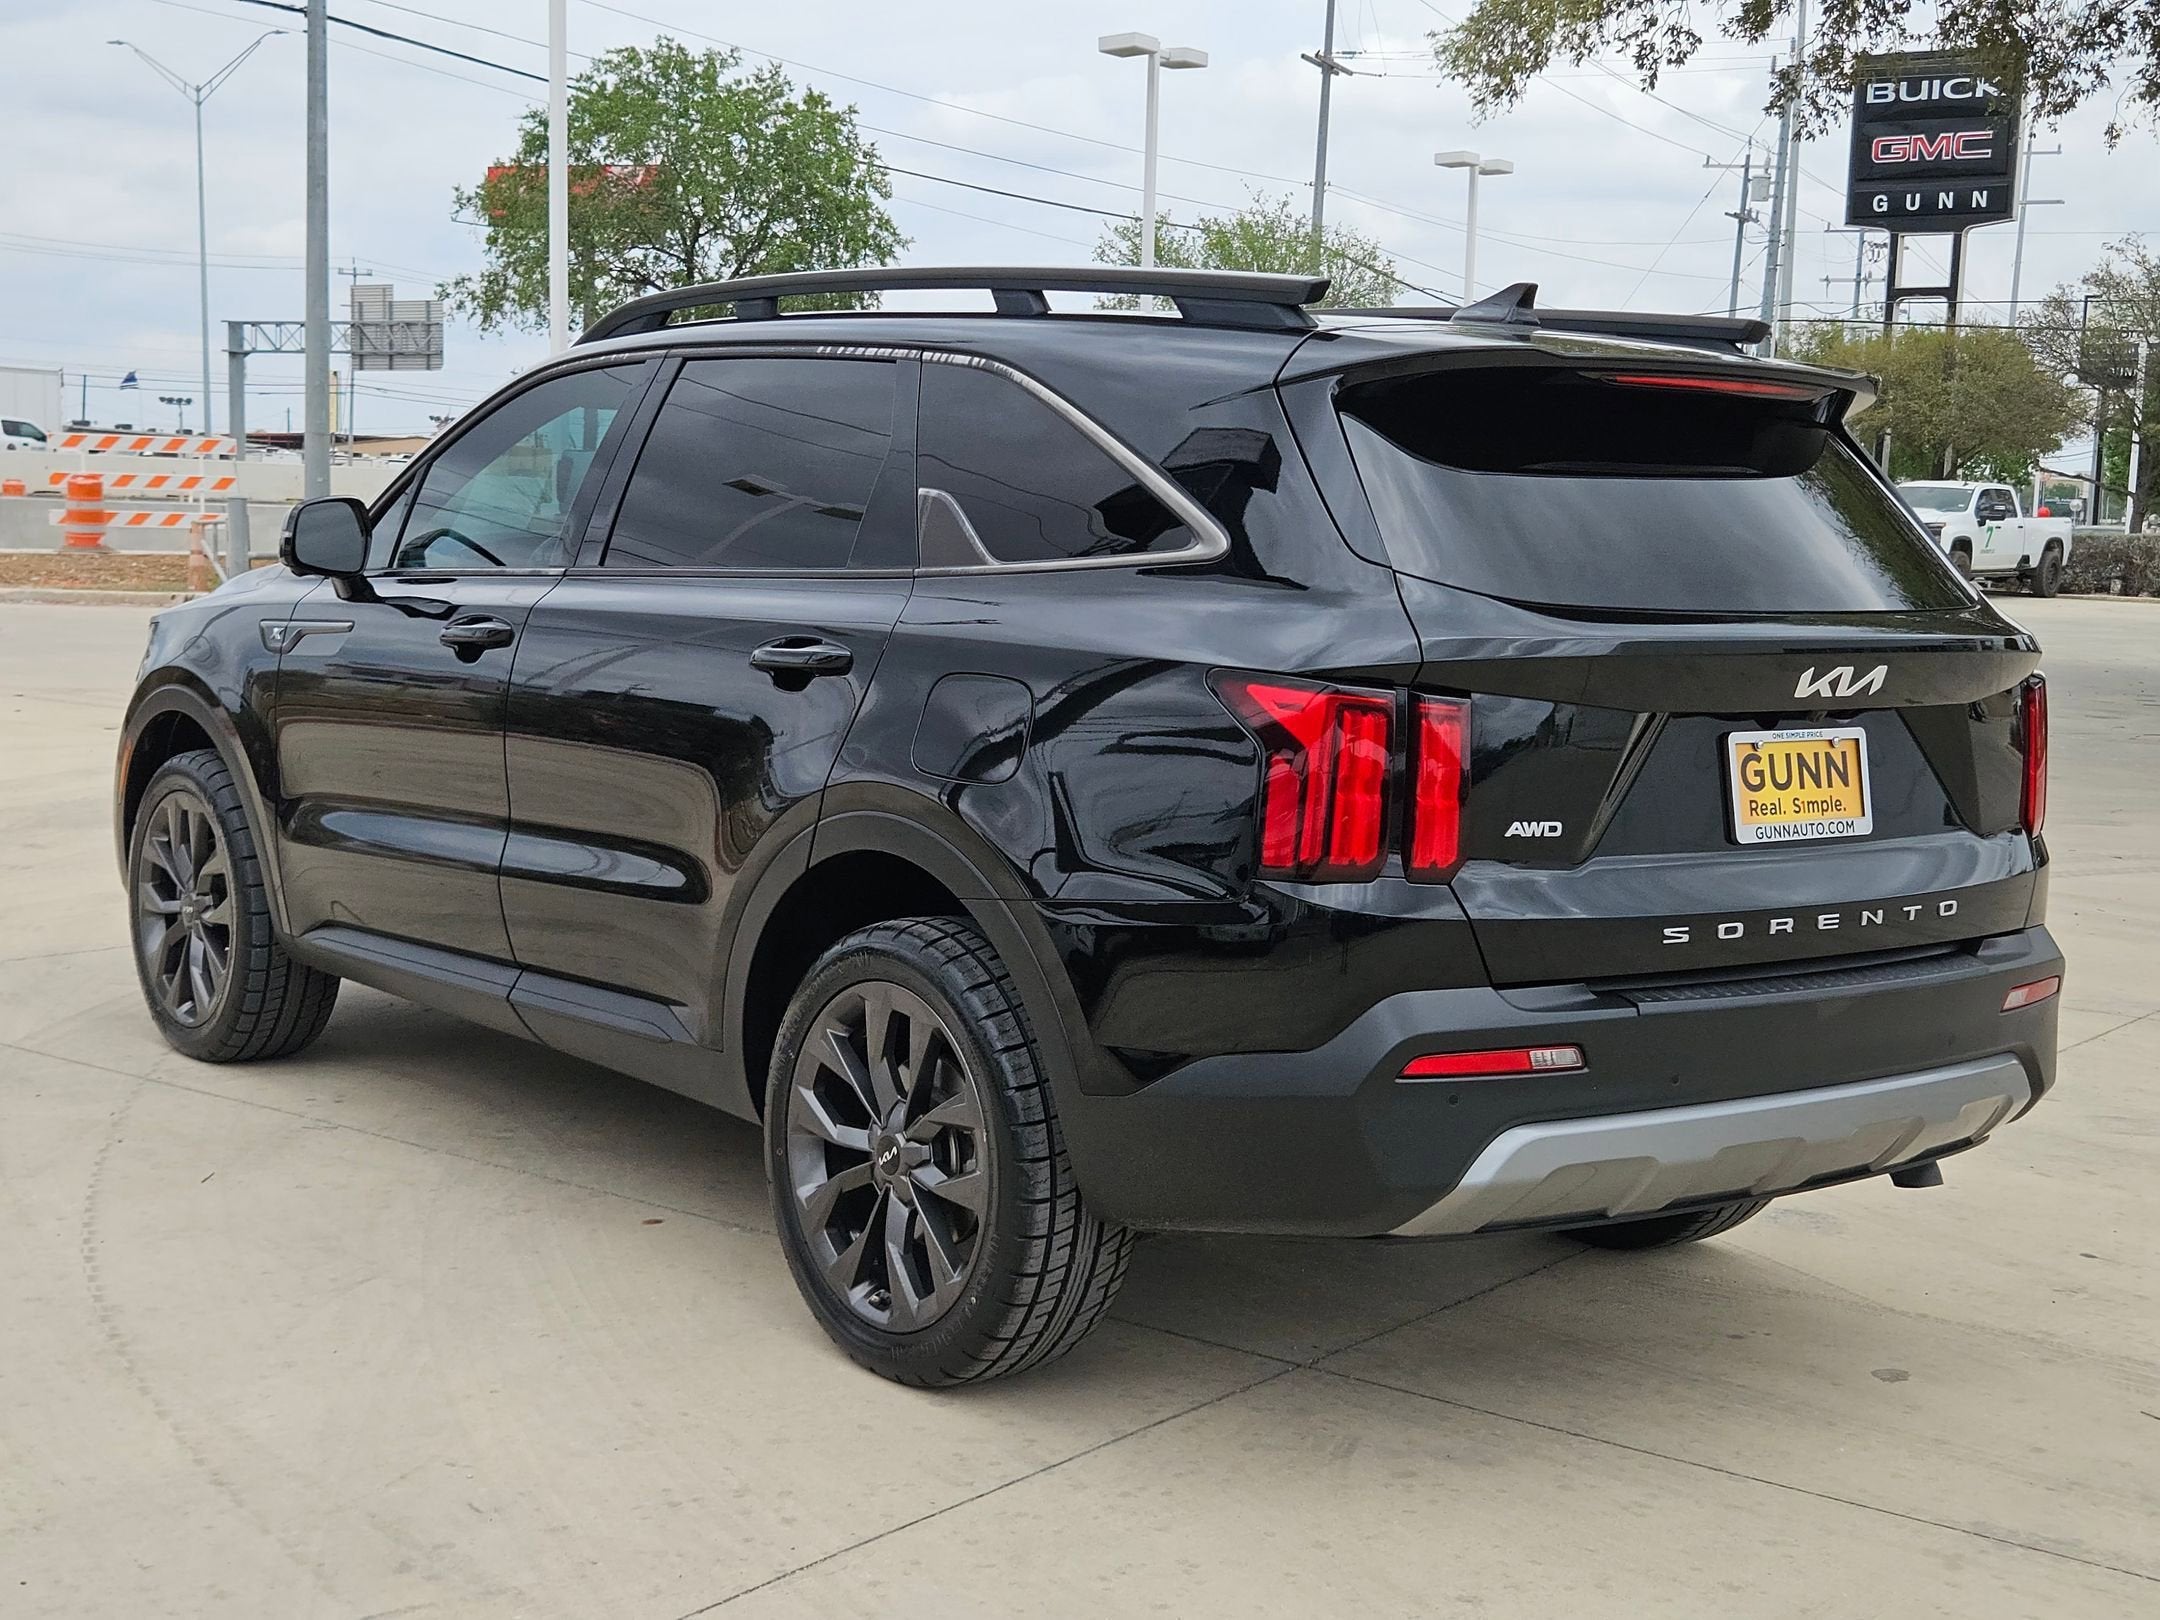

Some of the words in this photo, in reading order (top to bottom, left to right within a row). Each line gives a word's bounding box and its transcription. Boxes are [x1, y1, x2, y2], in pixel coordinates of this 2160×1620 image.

[1866, 77, 2005, 104] BUICK
[1872, 130, 1994, 164] GMC
[1872, 190, 1988, 213] GUNN
[1794, 665, 1888, 698] KIA
[1772, 732, 1785, 740] ONE
[1786, 731, 1805, 739] SIMPLE
[1807, 730, 1823, 738] PRICE
[1740, 751, 1850, 793] GUNN
[1749, 798, 1786, 817] Real.
[1504, 821, 1563, 838] AWD
[1755, 820, 1855, 840] GUNNAUTO.COM
[1662, 900, 1958, 944] SORENTO
